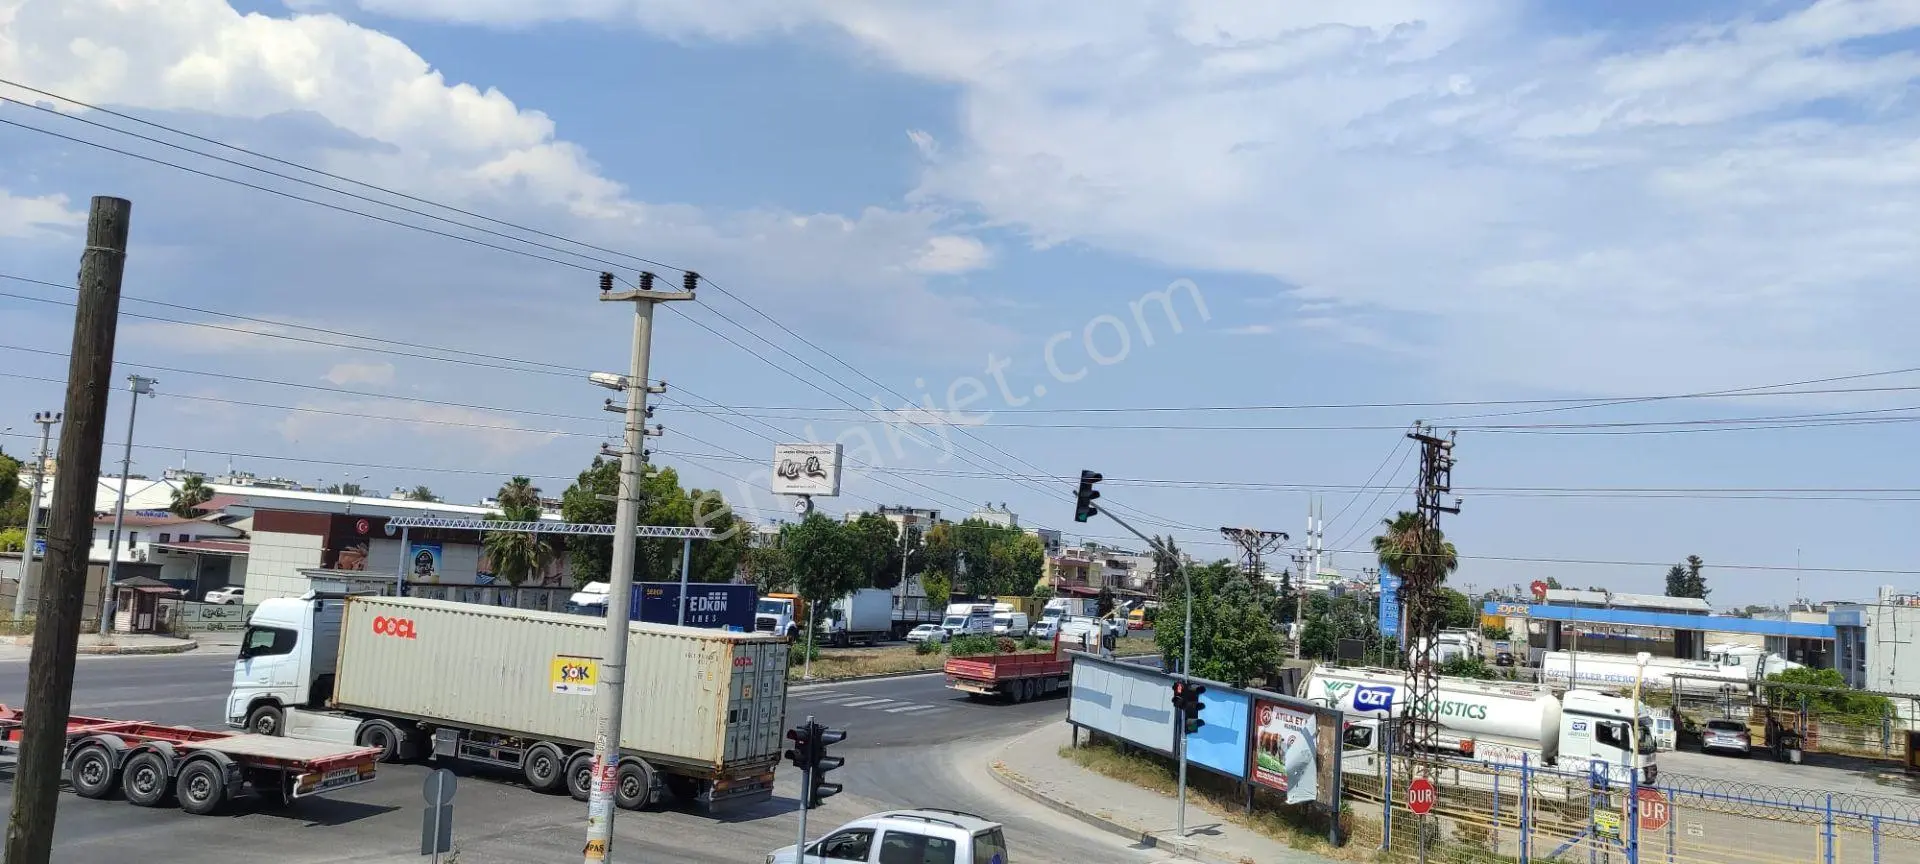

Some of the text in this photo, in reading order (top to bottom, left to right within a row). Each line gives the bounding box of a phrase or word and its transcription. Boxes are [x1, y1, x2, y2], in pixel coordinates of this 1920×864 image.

[678, 596, 727, 611] EDKON
[373, 615, 417, 639] OOCL
[1410, 789, 1432, 803] DUR
[1641, 800, 1665, 819] UR
